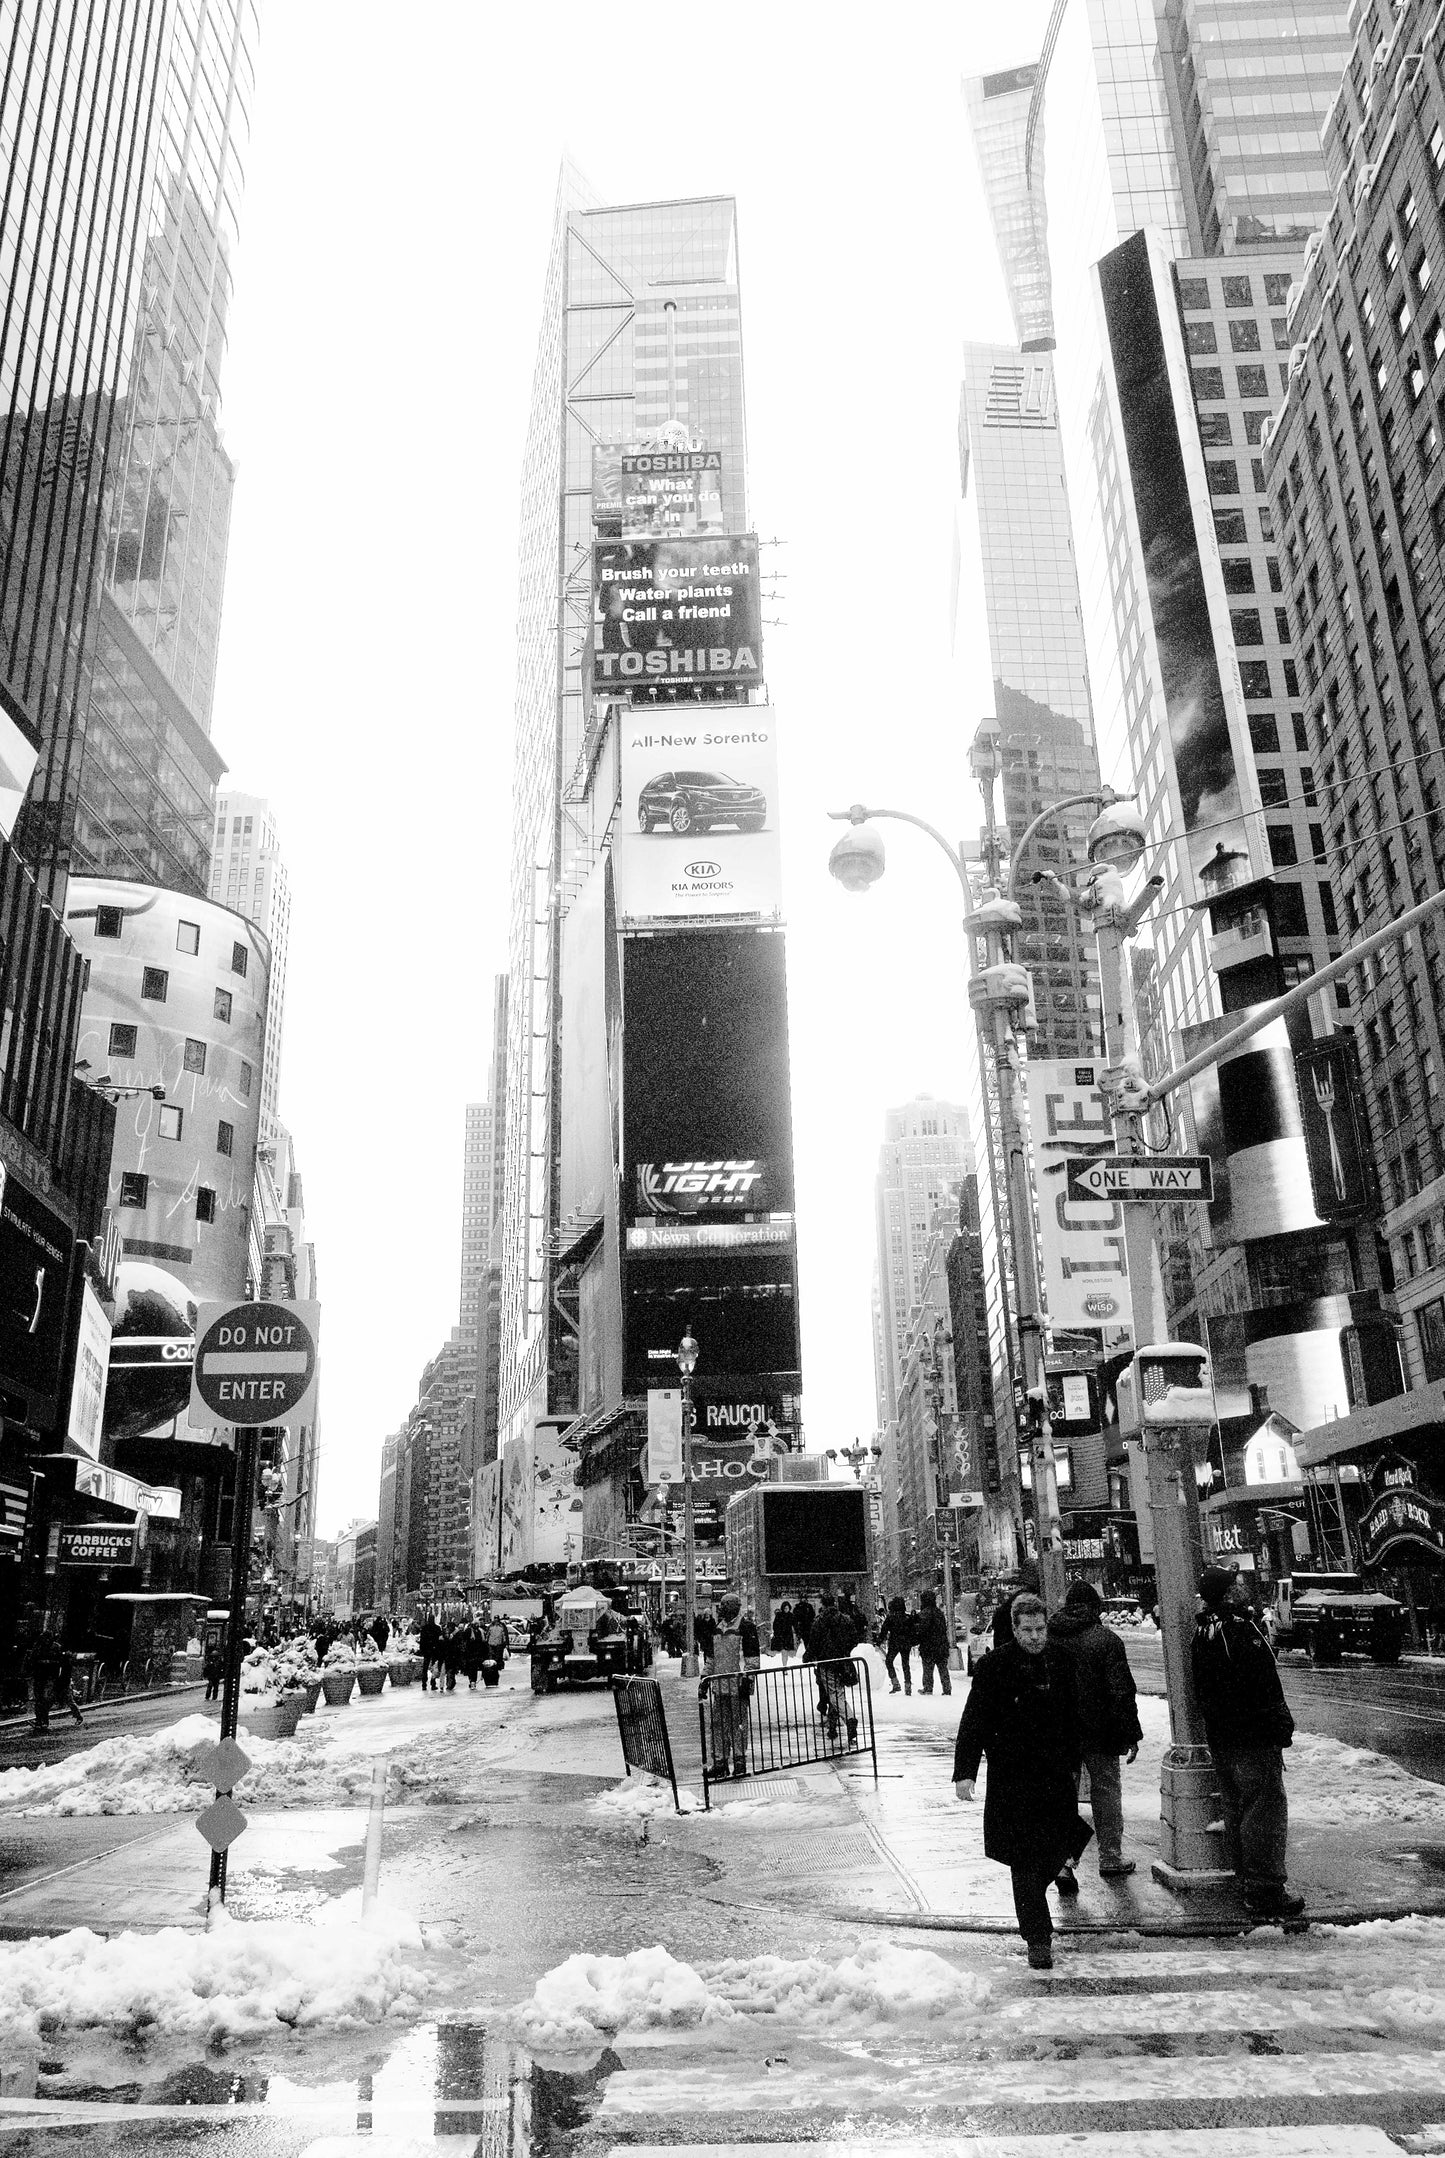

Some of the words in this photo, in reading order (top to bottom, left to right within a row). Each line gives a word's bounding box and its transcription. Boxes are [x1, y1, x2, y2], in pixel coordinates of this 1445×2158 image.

[623, 453, 721, 472] TOSHIBA
[649, 479, 694, 492] What
[626, 495, 657, 505] can
[662, 492, 693, 507] you
[699, 490, 720, 502] do
[665, 510, 680, 523] in
[601, 568, 653, 582] Brush
[658, 567, 698, 584] your
[703, 562, 750, 577] teeth
[619, 588, 672, 602] Water
[677, 584, 733, 602] plants
[622, 608, 656, 622] Call
[662, 610, 673, 620] a
[678, 603, 731, 619] friend
[596, 647, 758, 676] TOSHIBA
[660, 676, 694, 684] TOSHIBA
[631, 734, 697, 748] All-New
[702, 731, 769, 745] Sorento
[671, 882, 689, 891] KIA
[692, 880, 734, 890] MOTORS
[646, 1173, 762, 1193] LIGHT
[1089, 1170, 1130, 1188] ONE
[1150, 1170, 1192, 1188] WAY
[698, 1195, 745, 1203] BEER
[650, 1229, 690, 1245] News
[697, 1226, 788, 1244] Corporation
[219, 1327, 245, 1345] DO
[254, 1326, 296, 1345] NOT
[219, 1381, 286, 1400] ENTER
[71, 1546, 118, 1558] COFFEE
